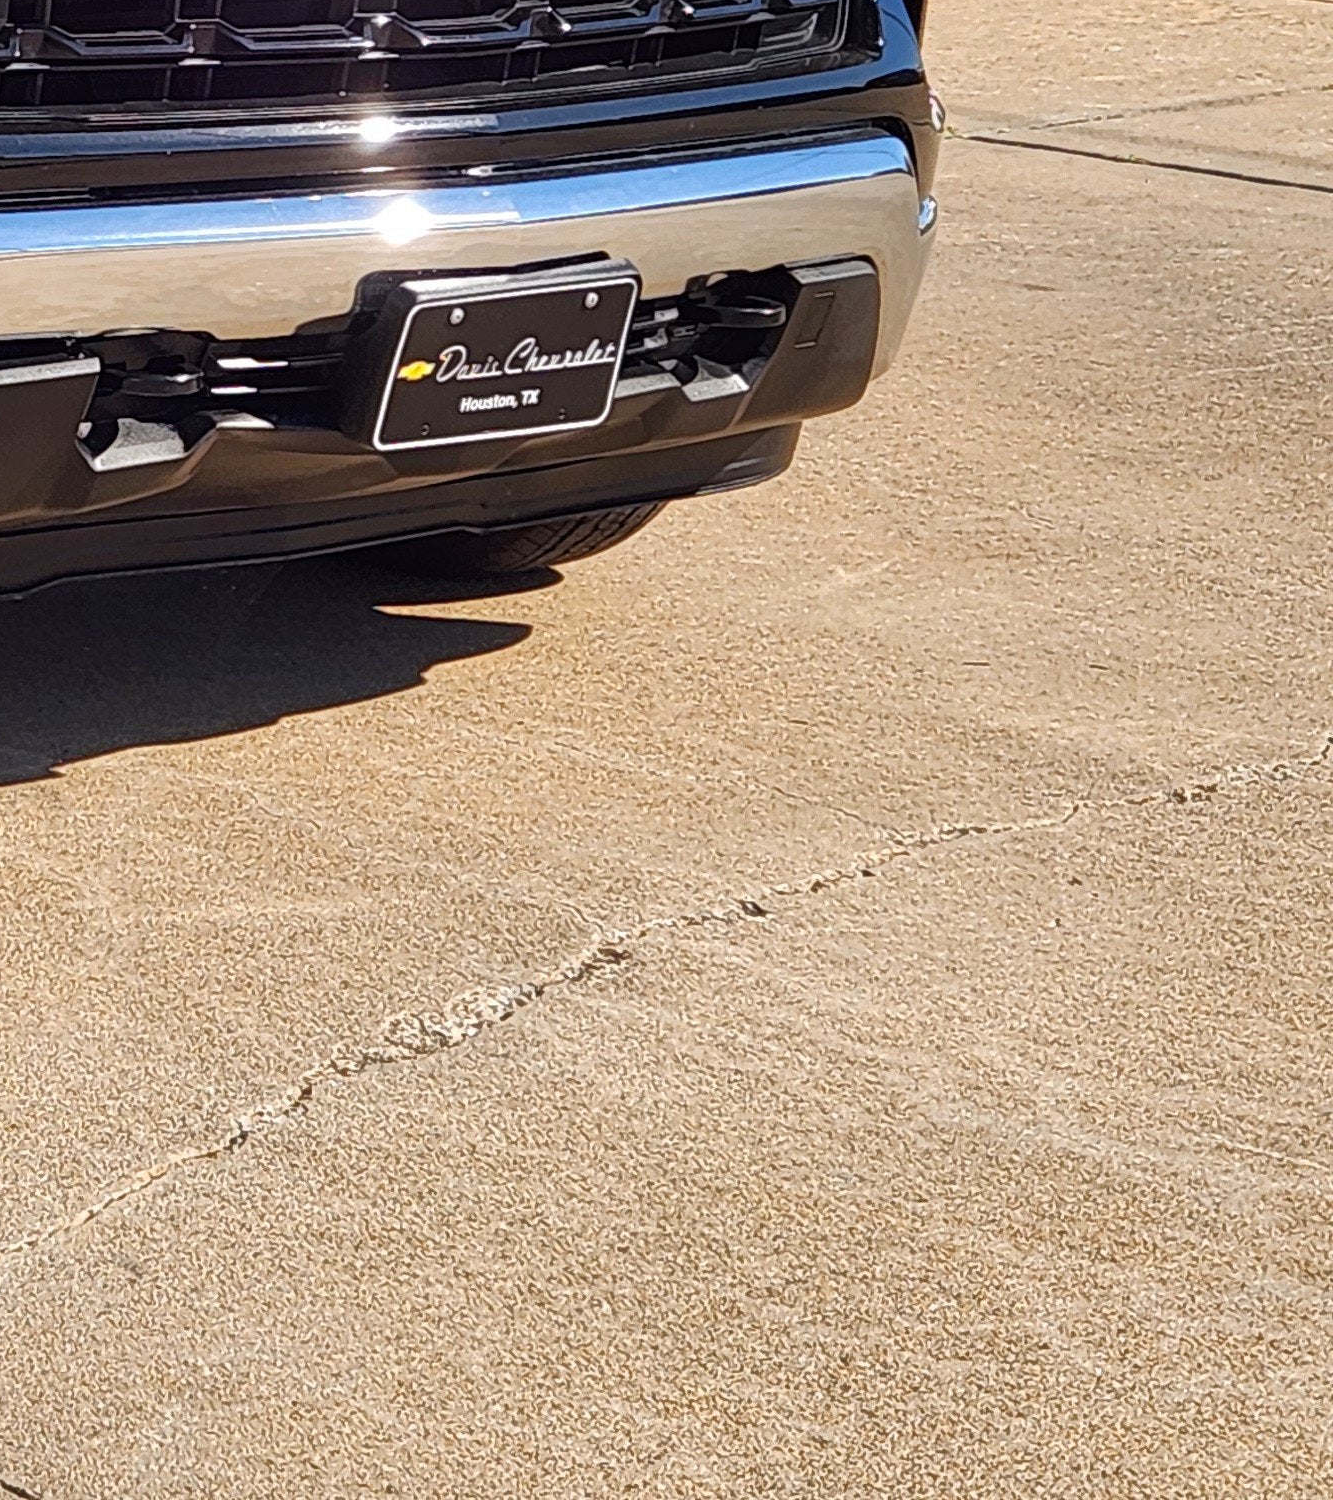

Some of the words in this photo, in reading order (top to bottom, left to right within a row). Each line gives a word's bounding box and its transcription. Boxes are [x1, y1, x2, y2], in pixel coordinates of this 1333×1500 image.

[435, 345, 503, 382] Davis
[504, 337, 616, 373] Chevrolet
[521, 388, 541, 406] TX
